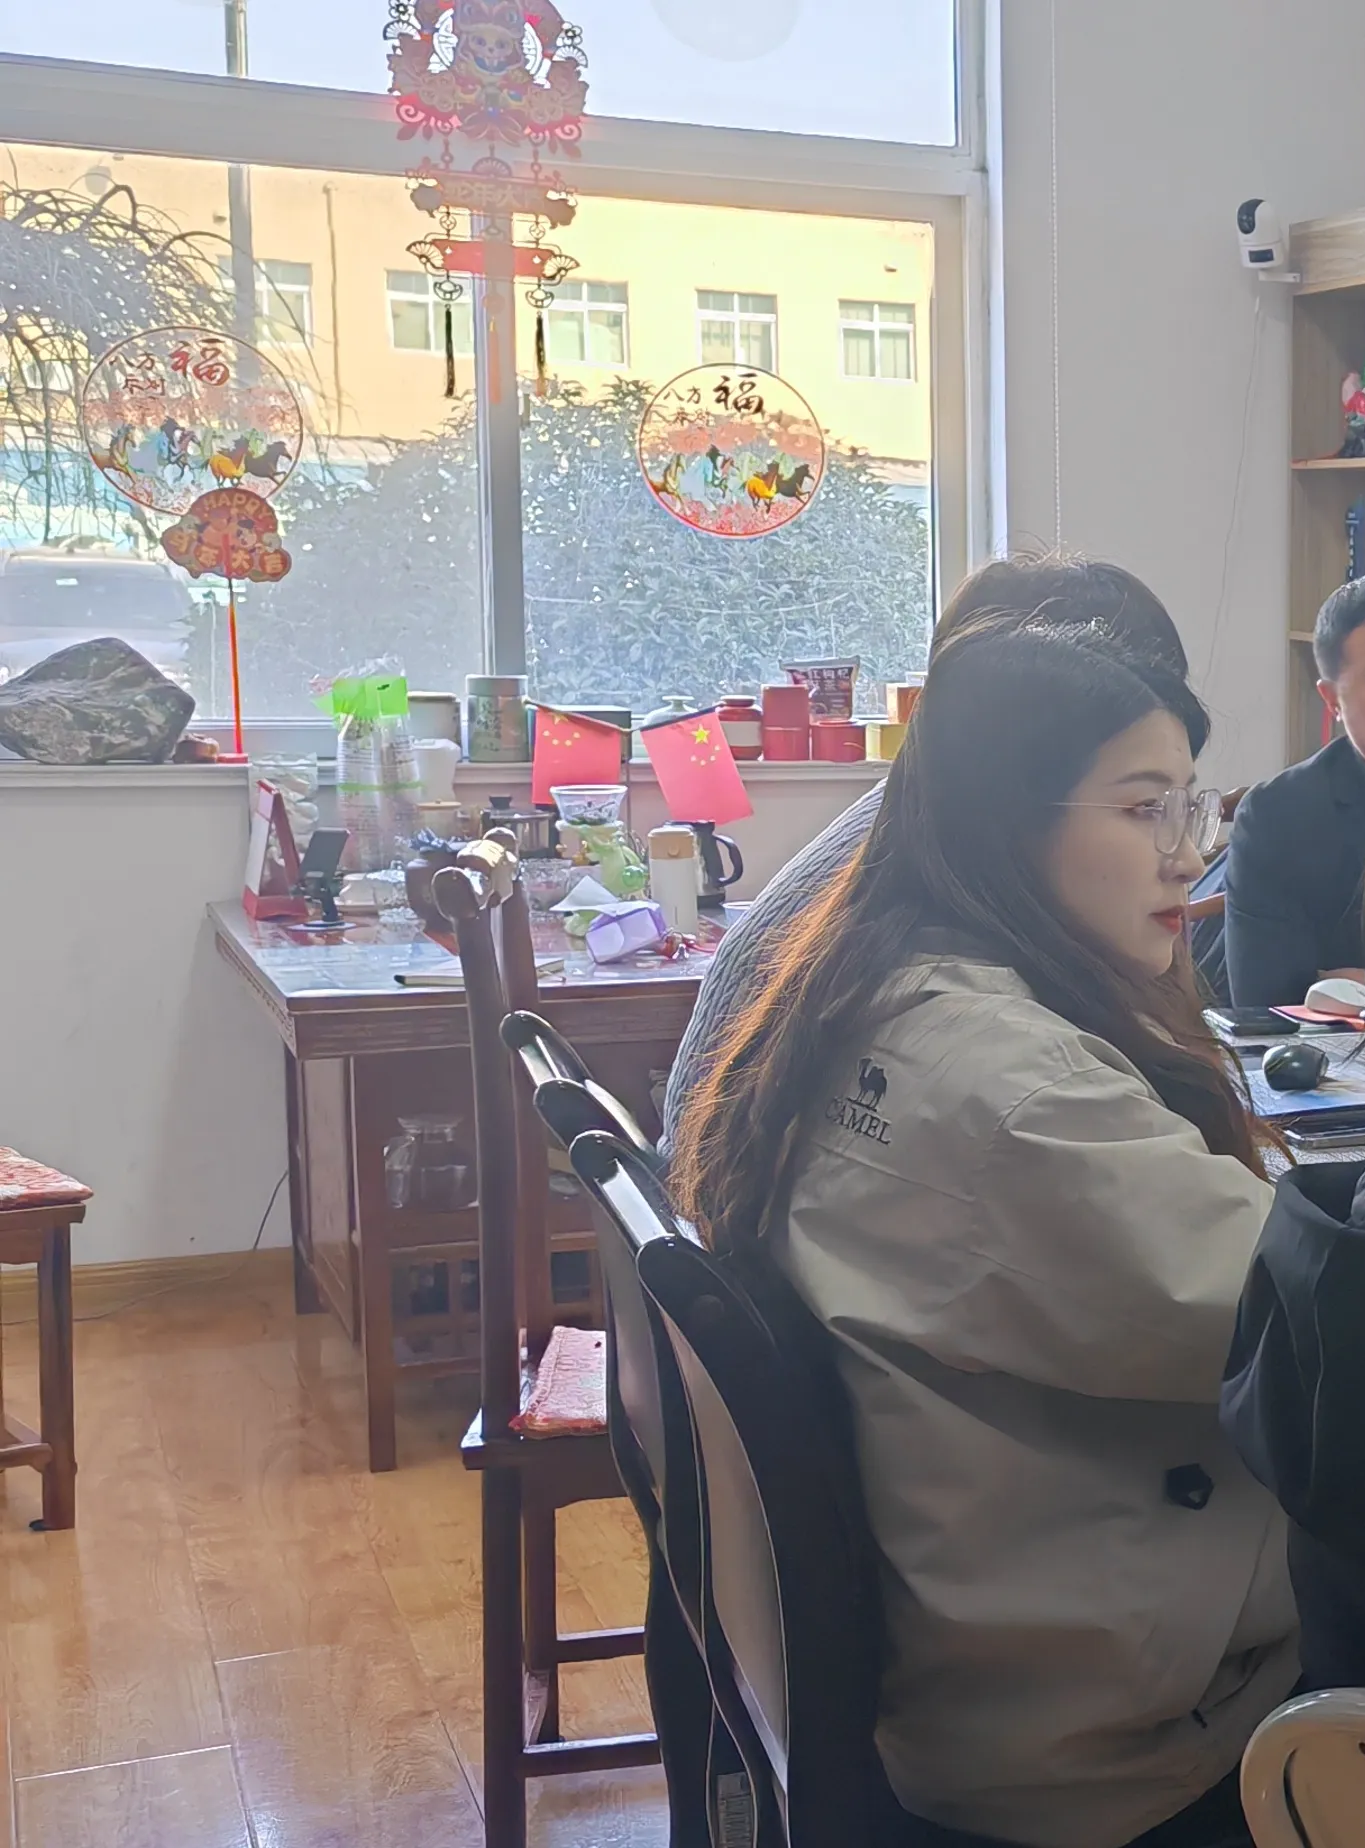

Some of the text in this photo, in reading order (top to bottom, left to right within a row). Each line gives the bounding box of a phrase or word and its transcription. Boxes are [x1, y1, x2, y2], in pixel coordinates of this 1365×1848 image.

[169, 337, 231, 387] 福
[712, 373, 764, 415] 福
[203, 492, 277, 519] HAPPY
[826, 1096, 892, 1146] CAMEL
